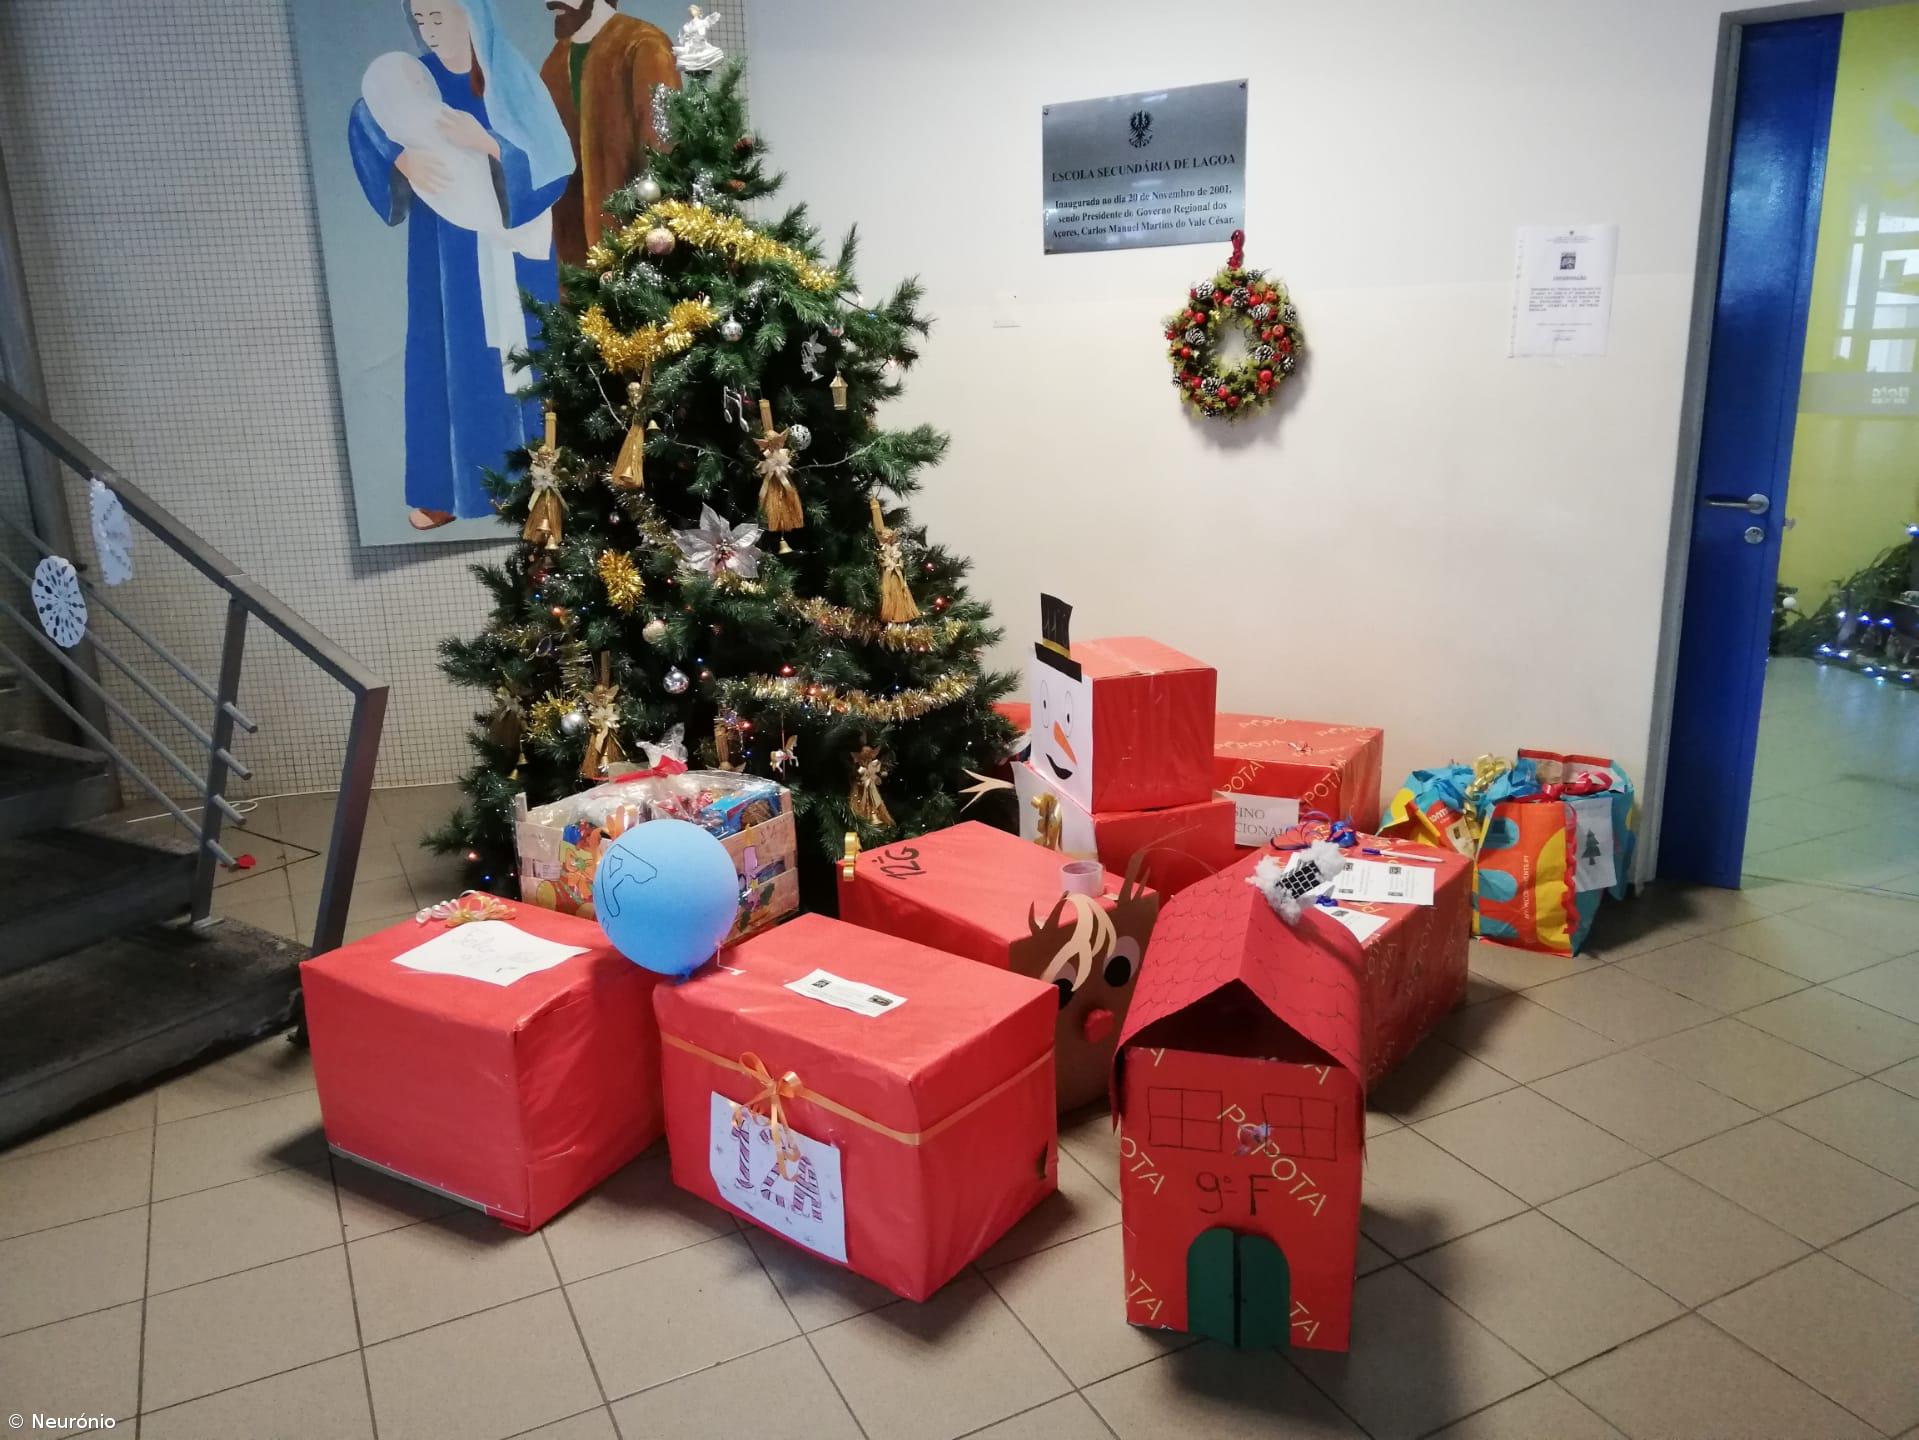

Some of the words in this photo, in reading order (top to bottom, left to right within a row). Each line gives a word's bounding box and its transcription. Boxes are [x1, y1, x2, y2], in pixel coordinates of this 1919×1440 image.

[1052, 169, 1095, 182] ESCOLA
[1097, 159, 1170, 177] SECUNDÁRIA
[1174, 158, 1189, 170] DE
[1193, 153, 1236, 168] LAGOA
[1055, 197, 1100, 209] Inaugurada
[1113, 194, 1126, 204] dia
[1140, 192, 1150, 200] de
[1152, 188, 1195, 200] Novembro
[1197, 187, 1208, 196] de
[1058, 213, 1080, 223] sendo
[1082, 210, 1122, 221] Presidente
[1136, 207, 1171, 217] Governo
[1174, 201, 1210, 214] Regional
[1212, 201, 1227, 210] dos
[1081, 226, 1107, 236] Carlos
[1108, 222, 1139, 233] Manuel
[1141, 220, 1174, 231] Martins
[1176, 219, 1186, 228] do
[1188, 217, 1206, 227] Vale
[1216, 1103, 1327, 1217] POPOTA
[1248, 1173, 1280, 1216] F
